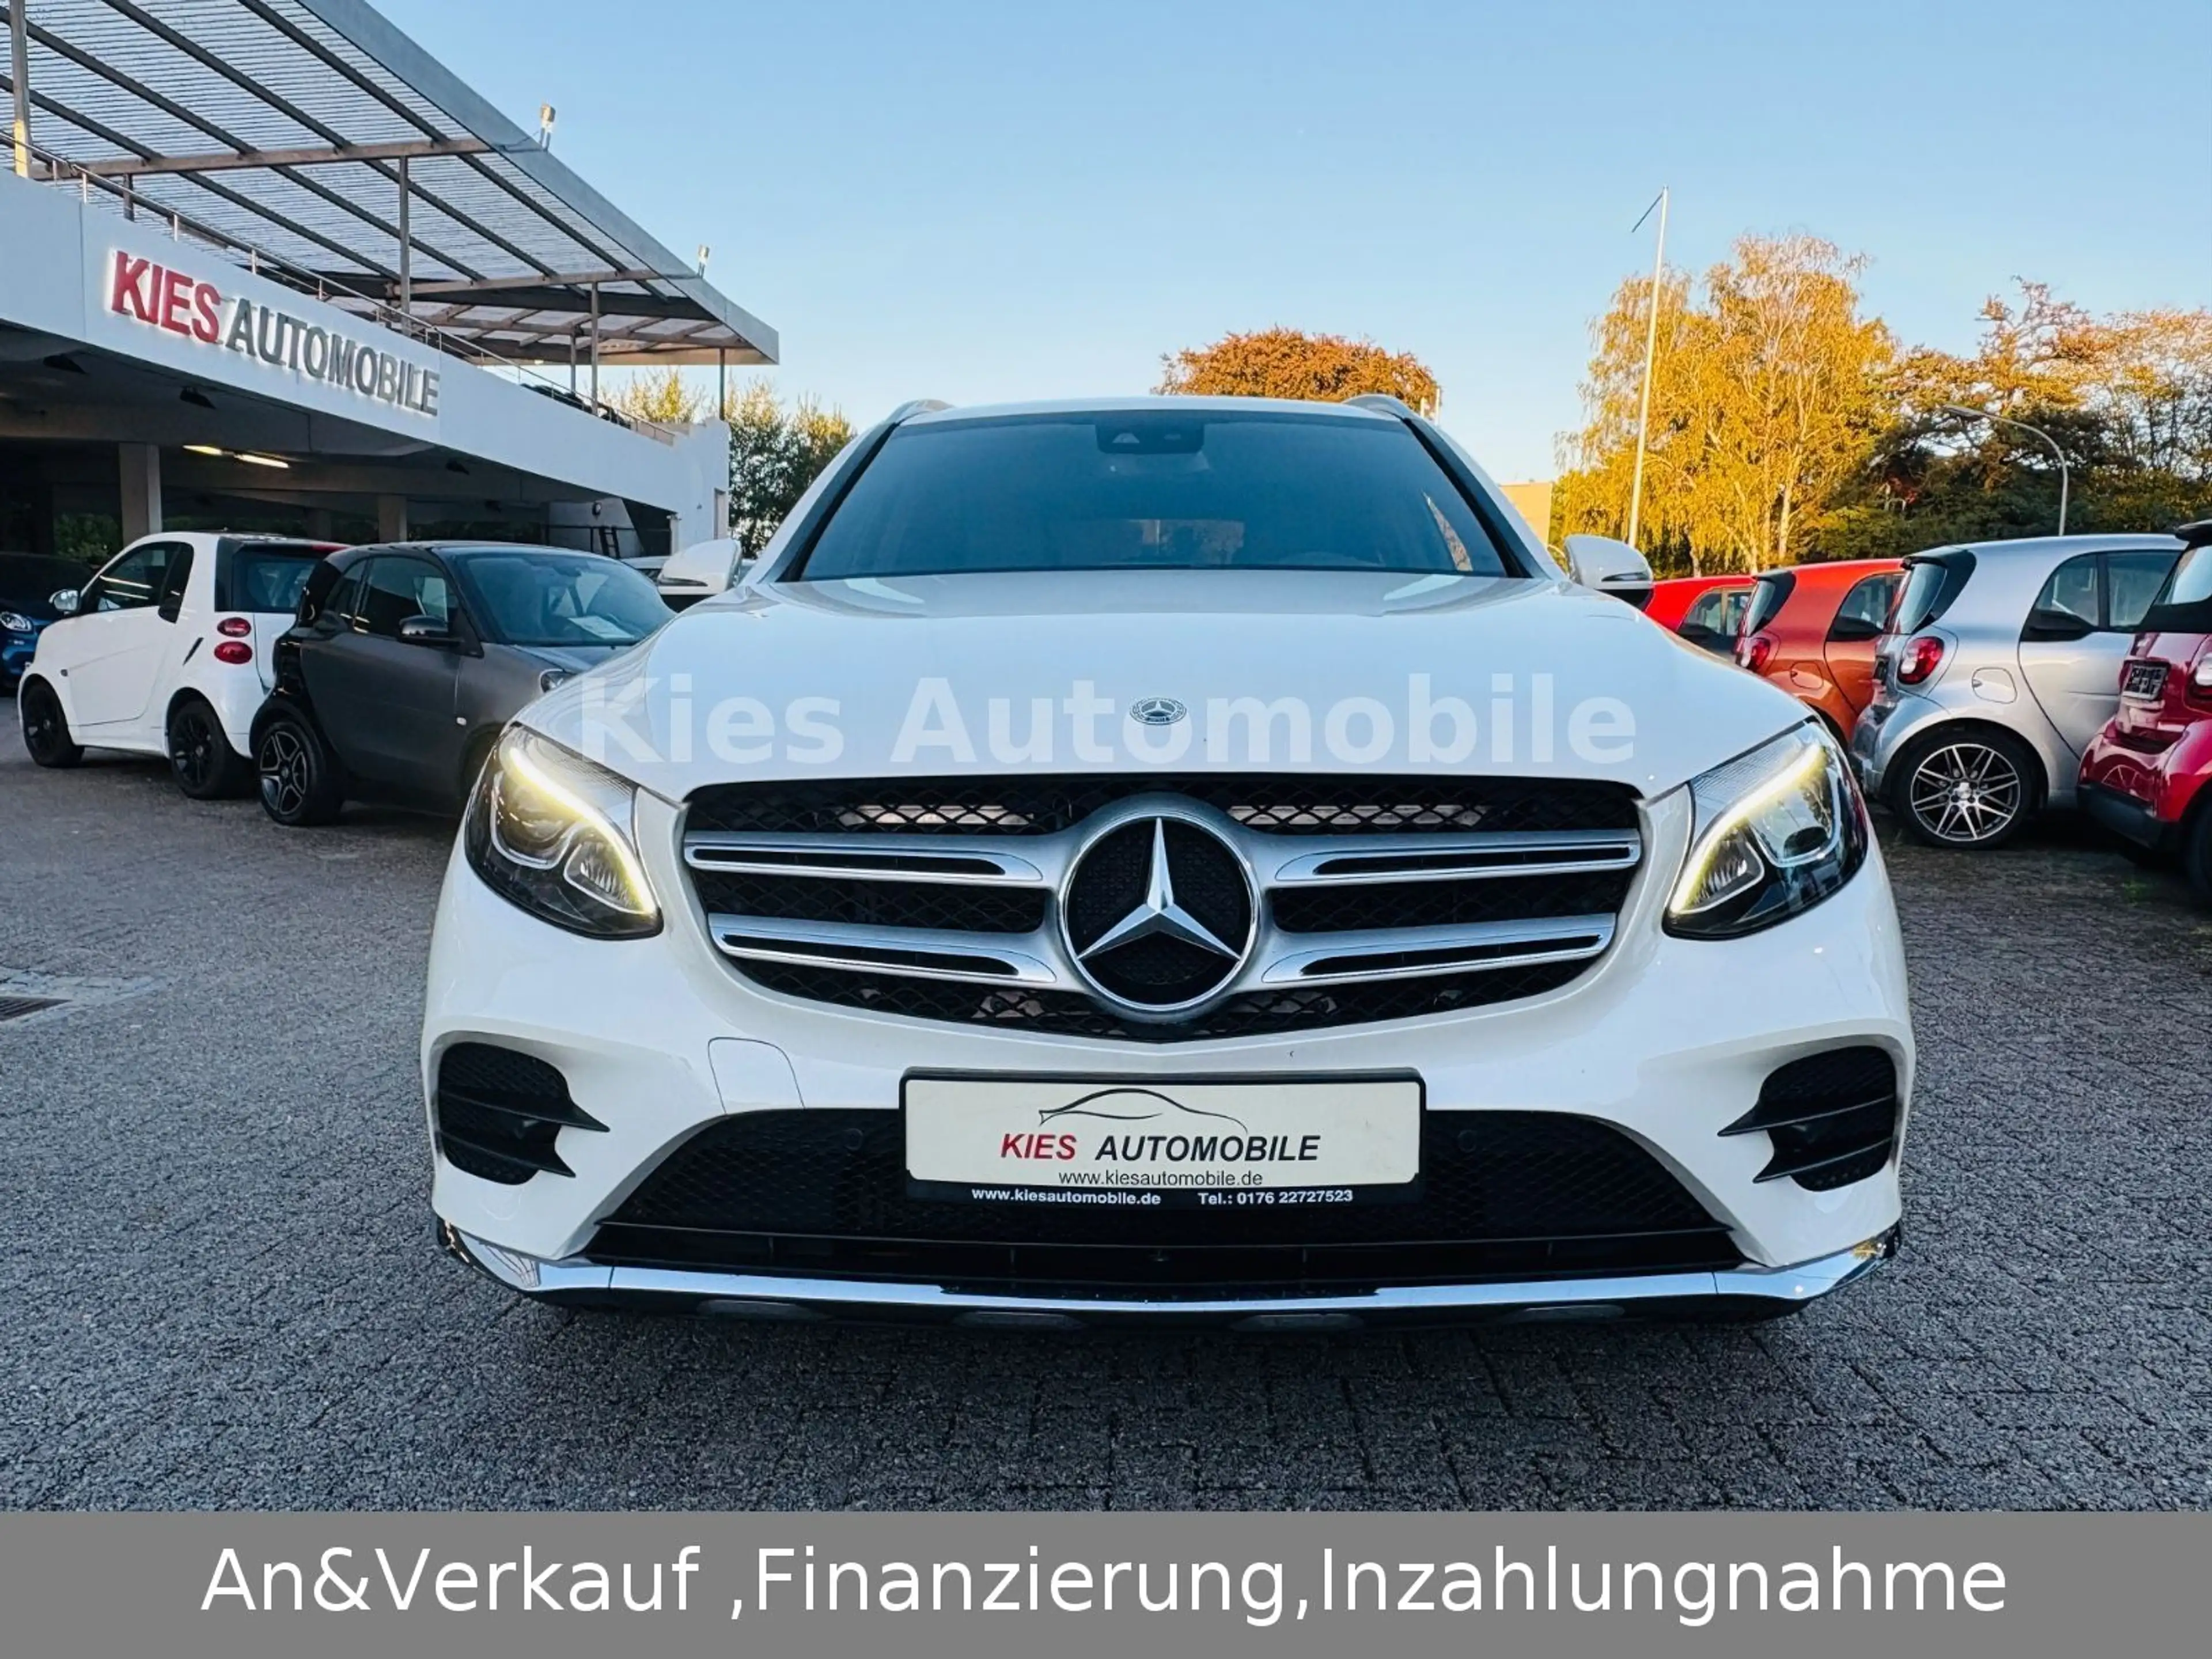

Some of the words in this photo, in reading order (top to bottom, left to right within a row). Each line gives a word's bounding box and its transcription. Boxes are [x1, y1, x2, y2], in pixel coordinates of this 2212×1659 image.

[111, 250, 221, 344] KIES
[225, 297, 441, 416] AUTOMOBILE
[1001, 1133, 1077, 1160] KIES
[1095, 1135, 1321, 1161] AUTOMOBILE
[1058, 1169, 1263, 1186] www.kiesautomobile.de
[971, 1187, 1162, 1205] www.kiesautomobile.de
[1198, 1192, 1233, 1205] Tel.:
[1236, 1191, 1275, 1205] 0176
[1278, 1189, 1354, 1204] 22727523
